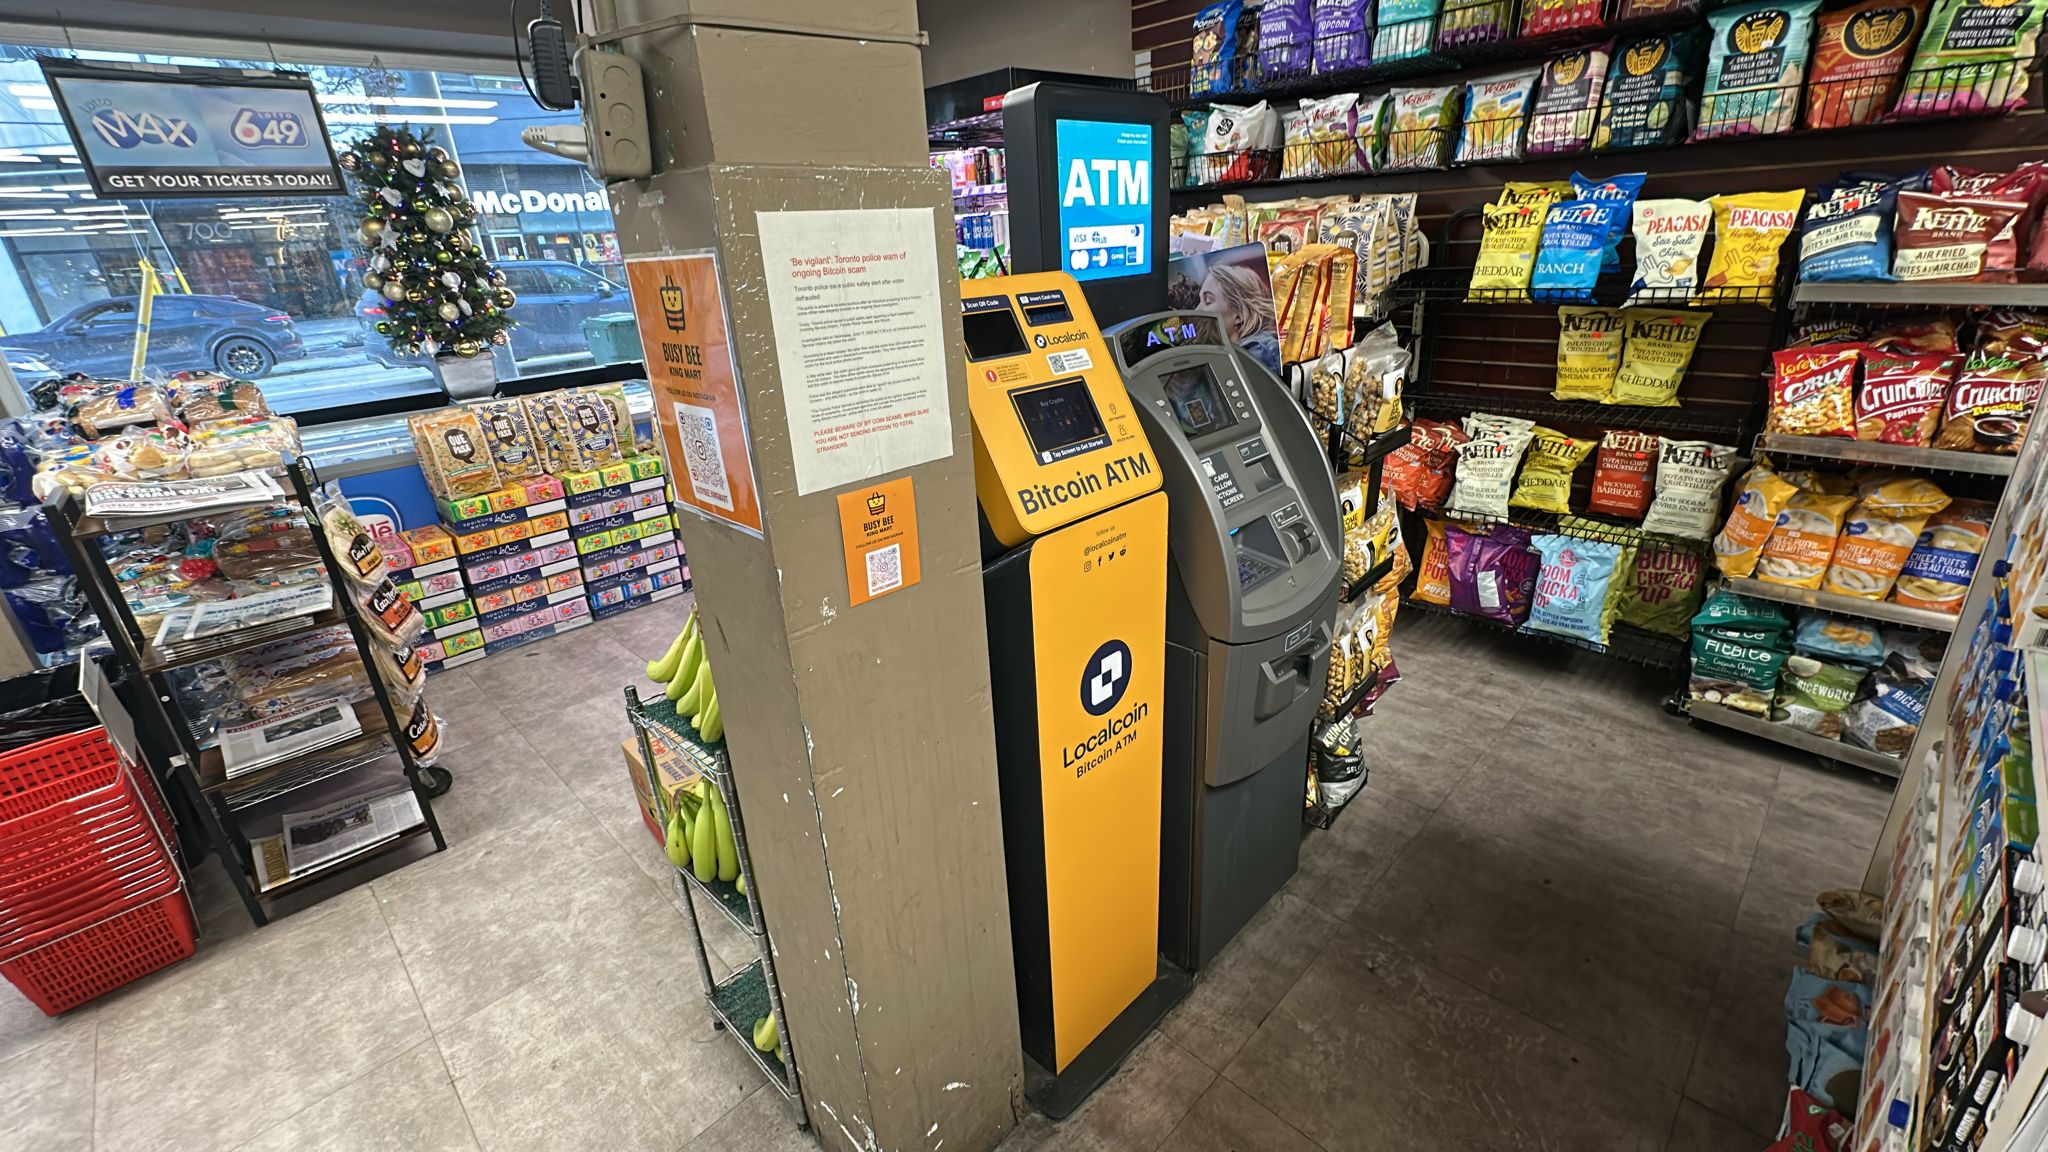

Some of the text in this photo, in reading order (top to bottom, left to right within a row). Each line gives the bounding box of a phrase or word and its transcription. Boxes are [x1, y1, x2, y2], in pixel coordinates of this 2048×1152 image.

[1262, 21, 1287, 33] POPCORN
[1318, 20, 1350, 31] POPCORN
[1730, 61, 1755, 71] TORTILLA
[91, 109, 196, 147] MAX
[109, 174, 333, 188] GET YOUR TICKETS TODAY!
[1063, 158, 1149, 207] ATM
[1646, 215, 1707, 235] PEACASA
[1730, 210, 1794, 228] PEACASA
[1834, 220, 1860, 231] FRIED
[1908, 207, 1991, 232] KETTLE
[186, 222, 233, 240] 700
[1073, 234, 1087, 243] VISA
[1652, 234, 1696, 247] Sea Salt
[834, 255, 860, 264] Toronto
[862, 254, 882, 264] police
[899, 252, 906, 260] of
[1659, 247, 1684, 258] Chips
[1916, 248, 1965, 259] AIR FRIED
[792, 266, 867, 279] ongoing Bitcoin scam
[1538, 263, 1585, 274] RANCH
[1895, 265, 1920, 274] FRITES
[1563, 311, 1624, 332] KETTLE
[1631, 316, 1698, 343] KETTLE
[1046, 330, 1089, 345] Localcoin
[662, 342, 702, 365] BUSY BEE
[669, 366, 701, 380] KING MART
[1620, 374, 1676, 389] CHEDDAR
[1783, 364, 1850, 402] CURLY
[1861, 377, 1945, 411] Crunchips
[1956, 382, 2038, 410] Crunchips
[580, 407, 594, 418] QUE
[1885, 406, 1924, 420] Paprika
[493, 419, 509, 430] QUE
[582, 417, 597, 426] PASA
[813, 426, 834, 436] PLEASE
[835, 423, 856, 433] BEWARE
[872, 417, 885, 425] COIN
[917, 408, 929, 416] SURE
[447, 433, 466, 445] QUE
[815, 437, 827, 445] YOU
[850, 428, 871, 437] SENDING
[872, 425, 892, 433] BITCOIN
[900, 420, 914, 428] TOTAL
[816, 442, 848, 453] STRANGERS
[1601, 430, 1659, 451] KETTLE
[452, 444, 471, 455] PASA
[1052, 450, 1061, 458] Tap
[1061, 445, 1076, 456] Screen
[1080, 442, 1088, 450] Get
[1088, 439, 1104, 448] Started
[1018, 452, 1151, 515] Bitcoin ATM
[1214, 472, 1229, 482] CARD
[1695, 477, 1717, 485] CHIPS
[1597, 486, 1642, 498] BARBEQUE
[1603, 481, 1637, 489] BACKYARD
[1223, 493, 1244, 506] SCREEN
[863, 515, 894, 532] BUSY BEE
[866, 526, 893, 537] KING MART
[1083, 532, 1127, 556] @localcoinatm
[1638, 544, 1700, 575] BOOM
[1844, 544, 1897, 561] CHEEZ PUFFS
[1910, 552, 1967, 568] CHEEZ PUFFS
[1929, 564, 1941, 572] AU
[1637, 570, 1696, 591] CHICKA
[1796, 679, 1856, 703] RICEWORKS
[1062, 701, 1149, 769] Localcoin
[1339, 727, 1353, 746] CUT
[1076, 730, 1137, 779] Bitcoin ATM
